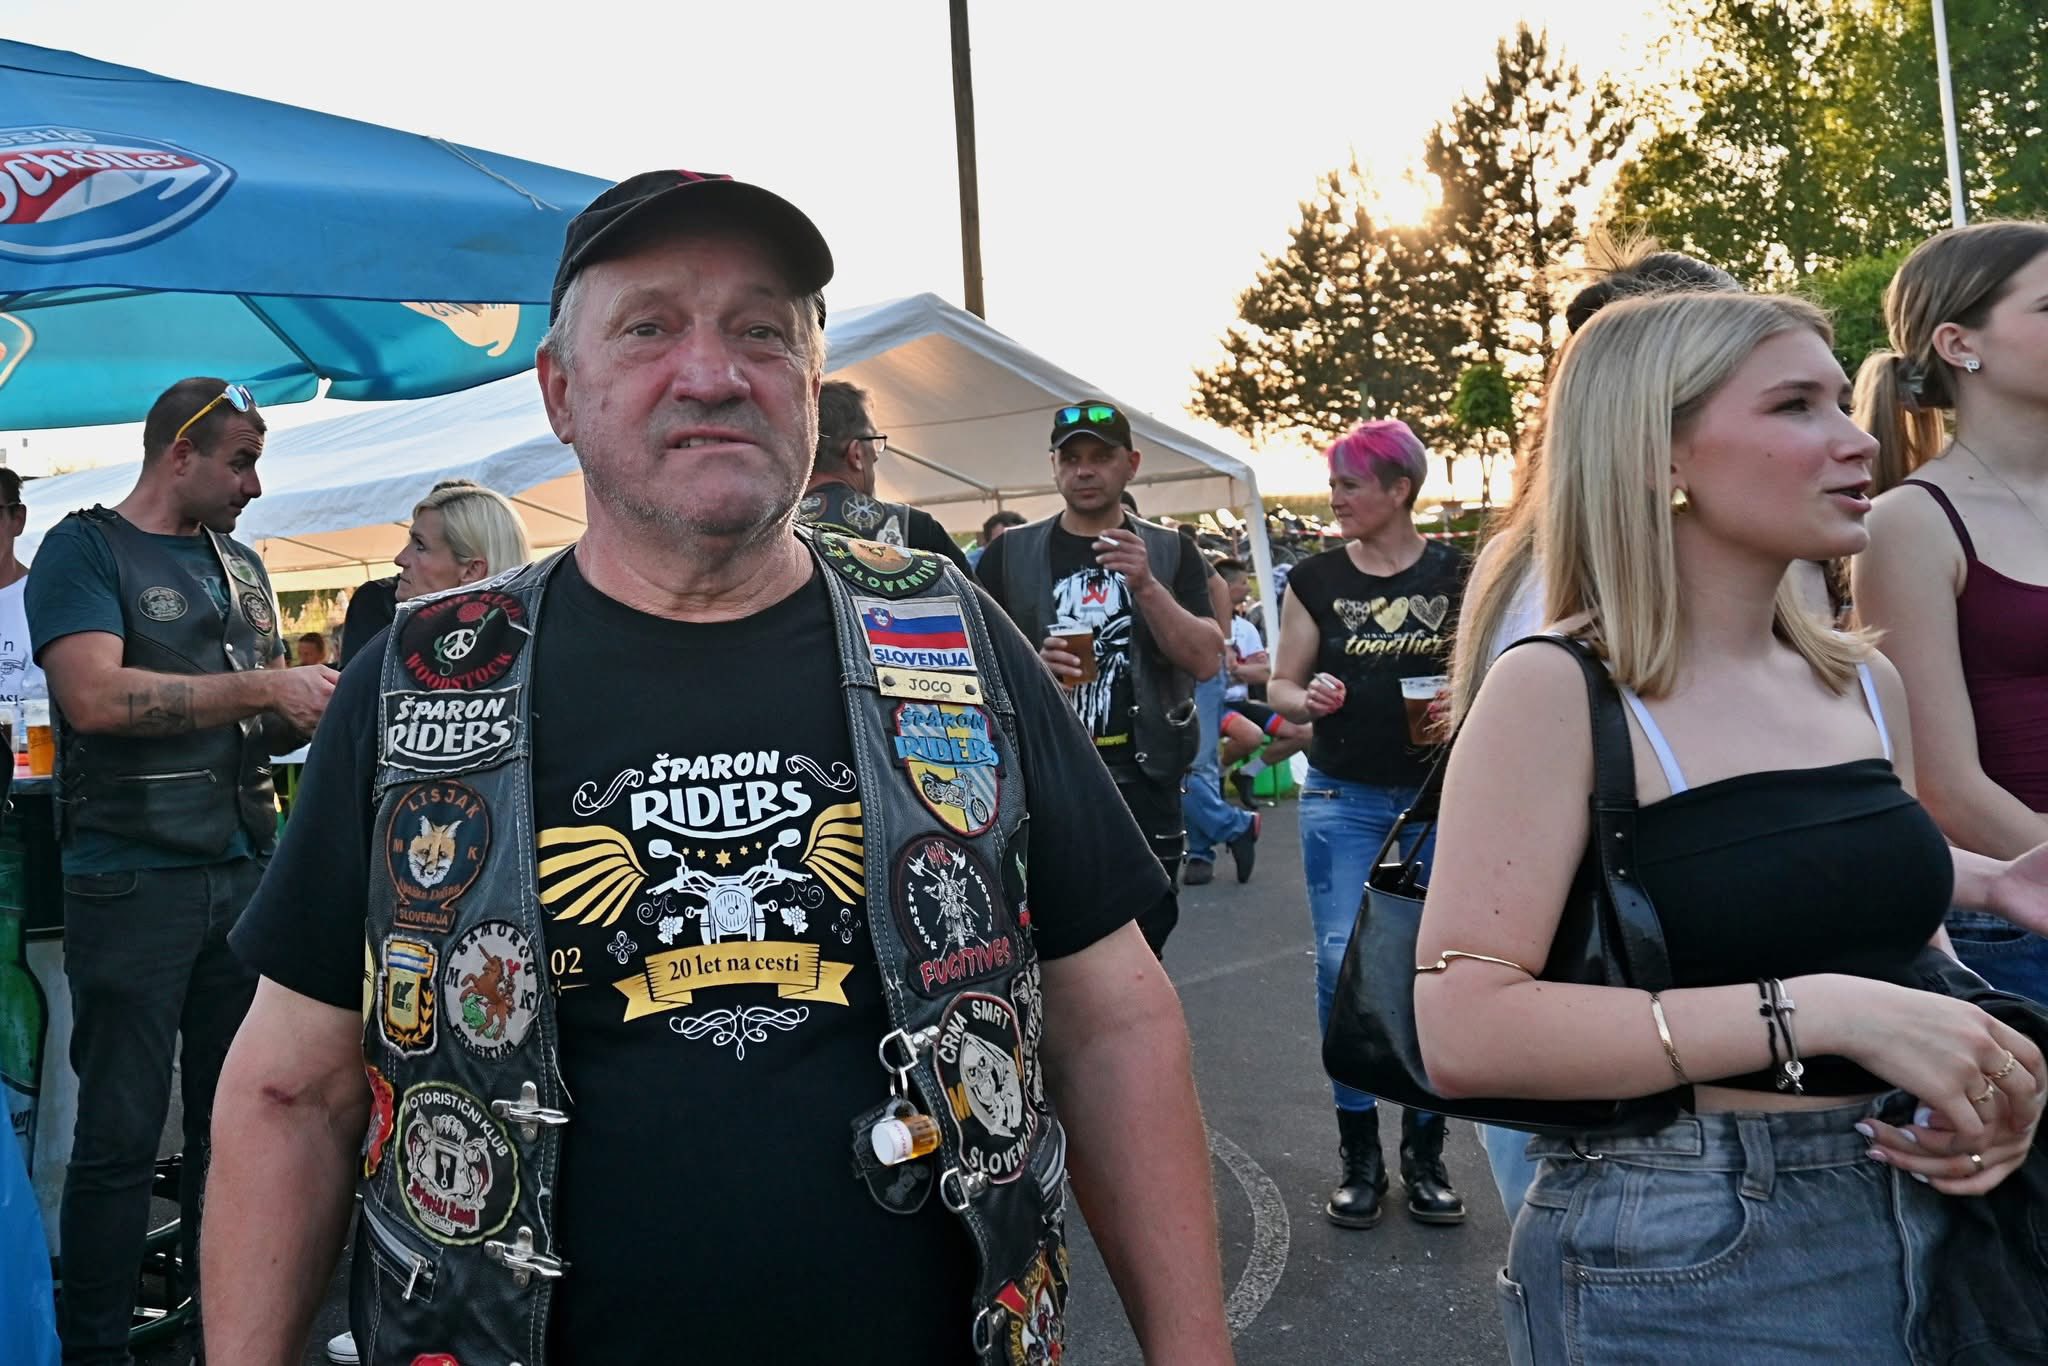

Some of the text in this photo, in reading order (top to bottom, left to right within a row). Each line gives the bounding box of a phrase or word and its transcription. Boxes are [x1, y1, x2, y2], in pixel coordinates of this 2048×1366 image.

[404, 651, 513, 690] WOODSTOCK
[874, 648, 971, 667] SLOVENIJA
[908, 678, 952, 695] JOCO
[394, 695, 506, 721] ŠPARON
[386, 720, 512, 762] RIDERS
[894, 735, 999, 769] RIDERS
[648, 750, 780, 784] ŠPARON
[406, 788, 480, 820] LISJAK
[630, 780, 812, 840] RIDERS
[466, 846, 479, 861] K
[398, 909, 449, 926] SLOVENIJA
[456, 923, 537, 977] SAMOROG
[668, 953, 799, 981] 20 let na cesti
[919, 936, 1011, 993] FUGITIVES
[446, 967, 461, 988] M
[938, 1010, 968, 1064] CRNA
[971, 1000, 1011, 1030] SMRT
[479, 1120, 509, 1157] KLUB
[969, 1112, 1034, 1175] SLOVENIJA
